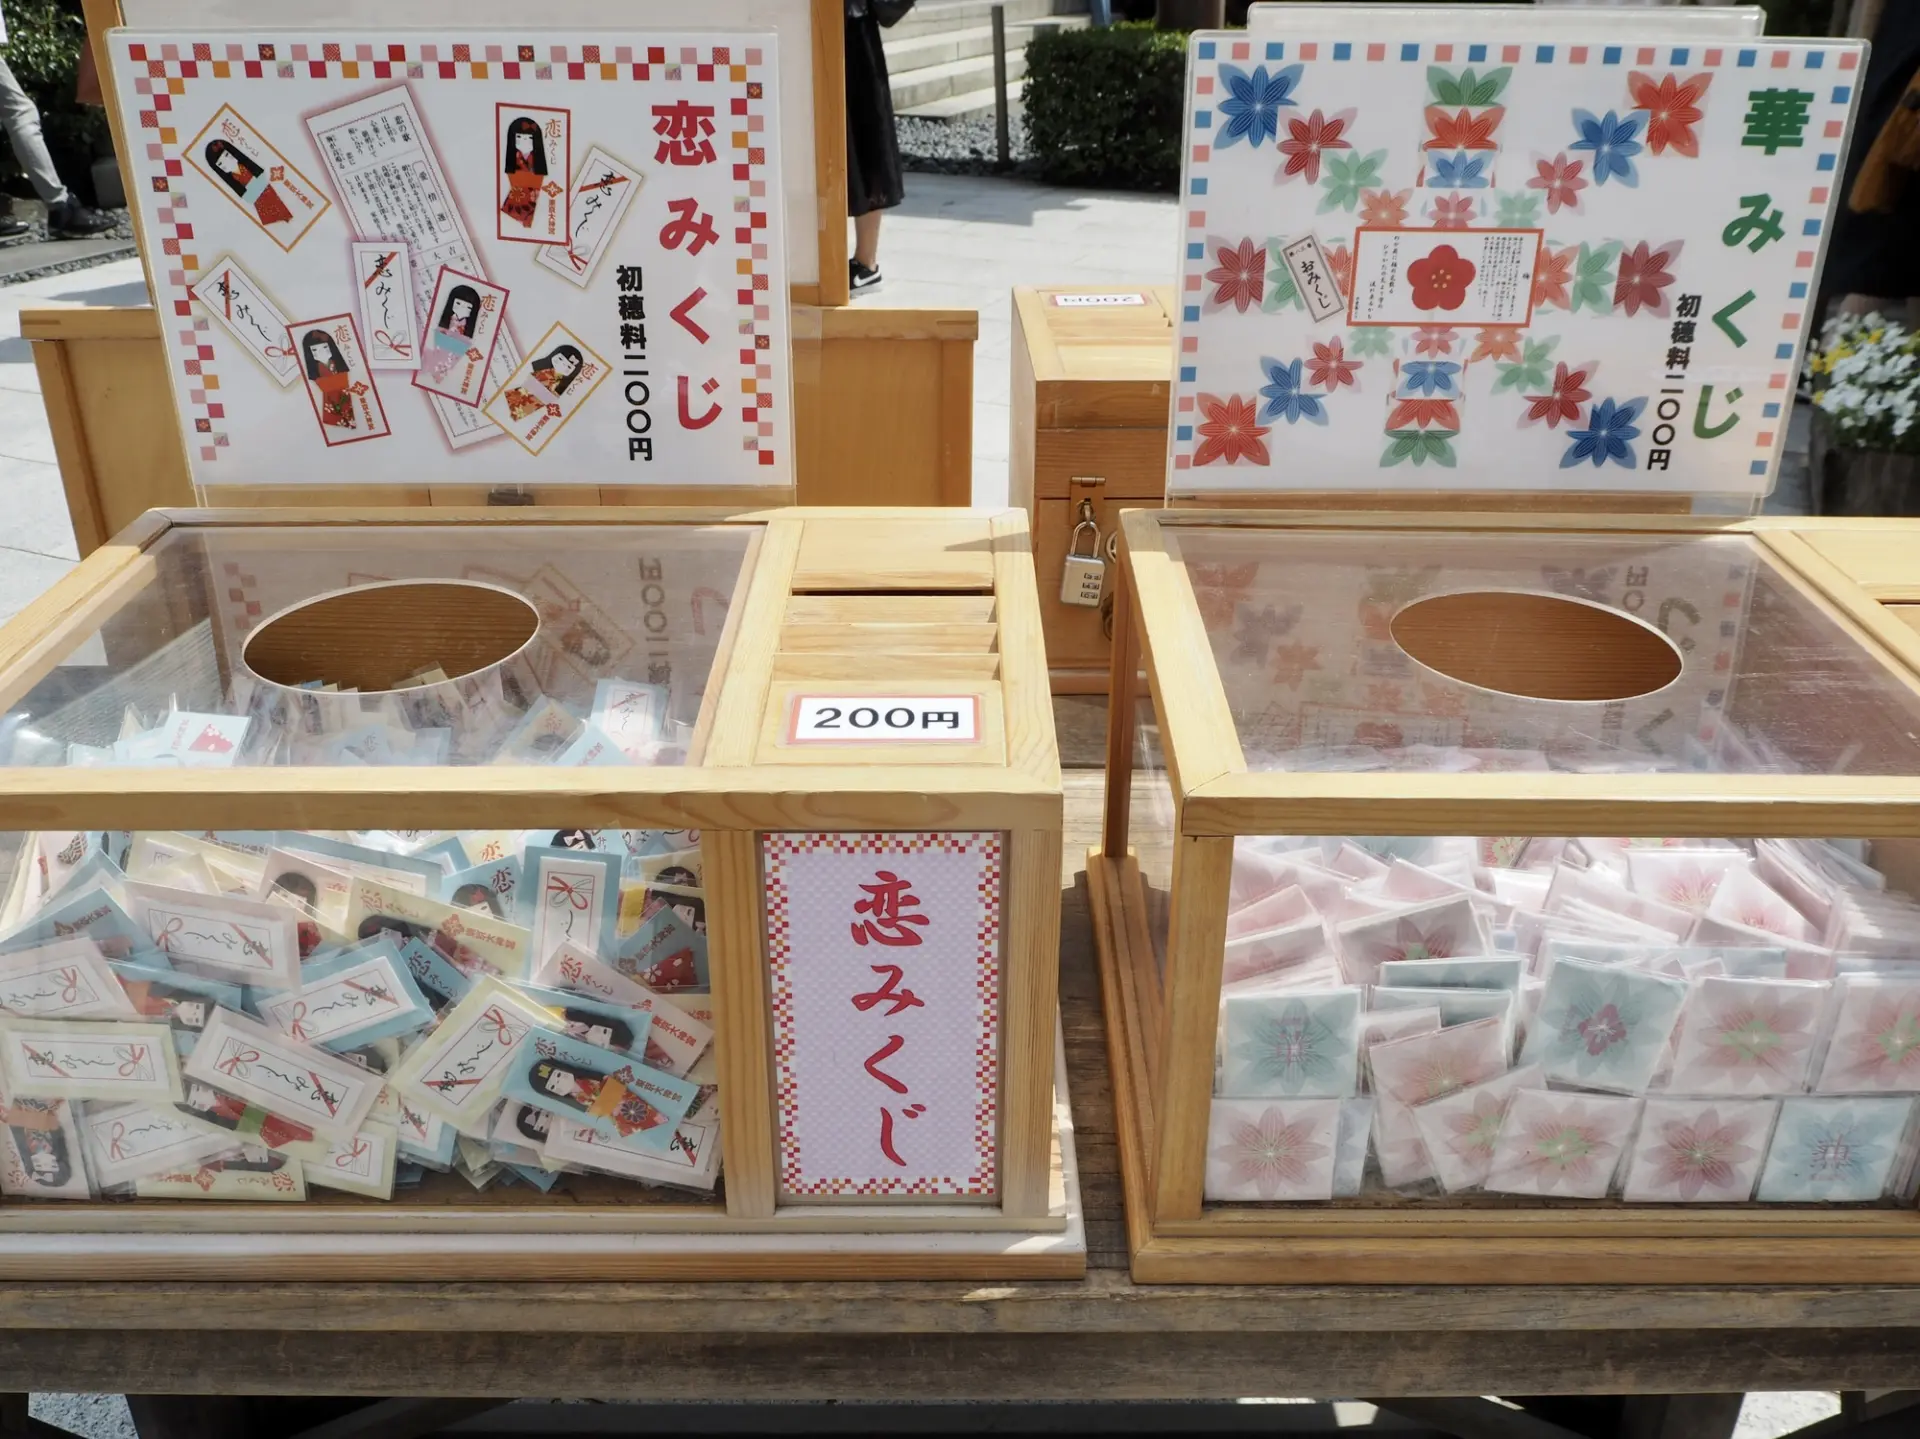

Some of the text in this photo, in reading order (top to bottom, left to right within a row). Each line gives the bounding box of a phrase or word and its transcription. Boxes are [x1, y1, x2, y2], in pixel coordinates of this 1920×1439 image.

[221, 118, 259, 157] 恋みくじ
[544, 118, 562, 165] 恋みくじ
[651, 99, 723, 430] 恋みくじ
[1300, 260, 1331, 309] おみくじ
[1692, 87, 1815, 440] 華みくじ
[479, 294, 497, 335] 恋みくじ
[334, 324, 356, 368] 恋みくじ
[616, 265, 653, 462] 初穂料二〇〇円
[566, 362, 599, 396] 恋みくじ
[1646, 294, 1702, 471] 初穂料二〇〇円
[813, 707, 959, 729] 200円
[559, 953, 614, 996] 恋みくじ
[651, 1015, 697, 1047] 東京大神宮
[851, 870, 930, 1166] 恋みくじ
[534, 1036, 593, 1066] 恋みくじ
[635, 1079, 683, 1102] 東京大神宮
